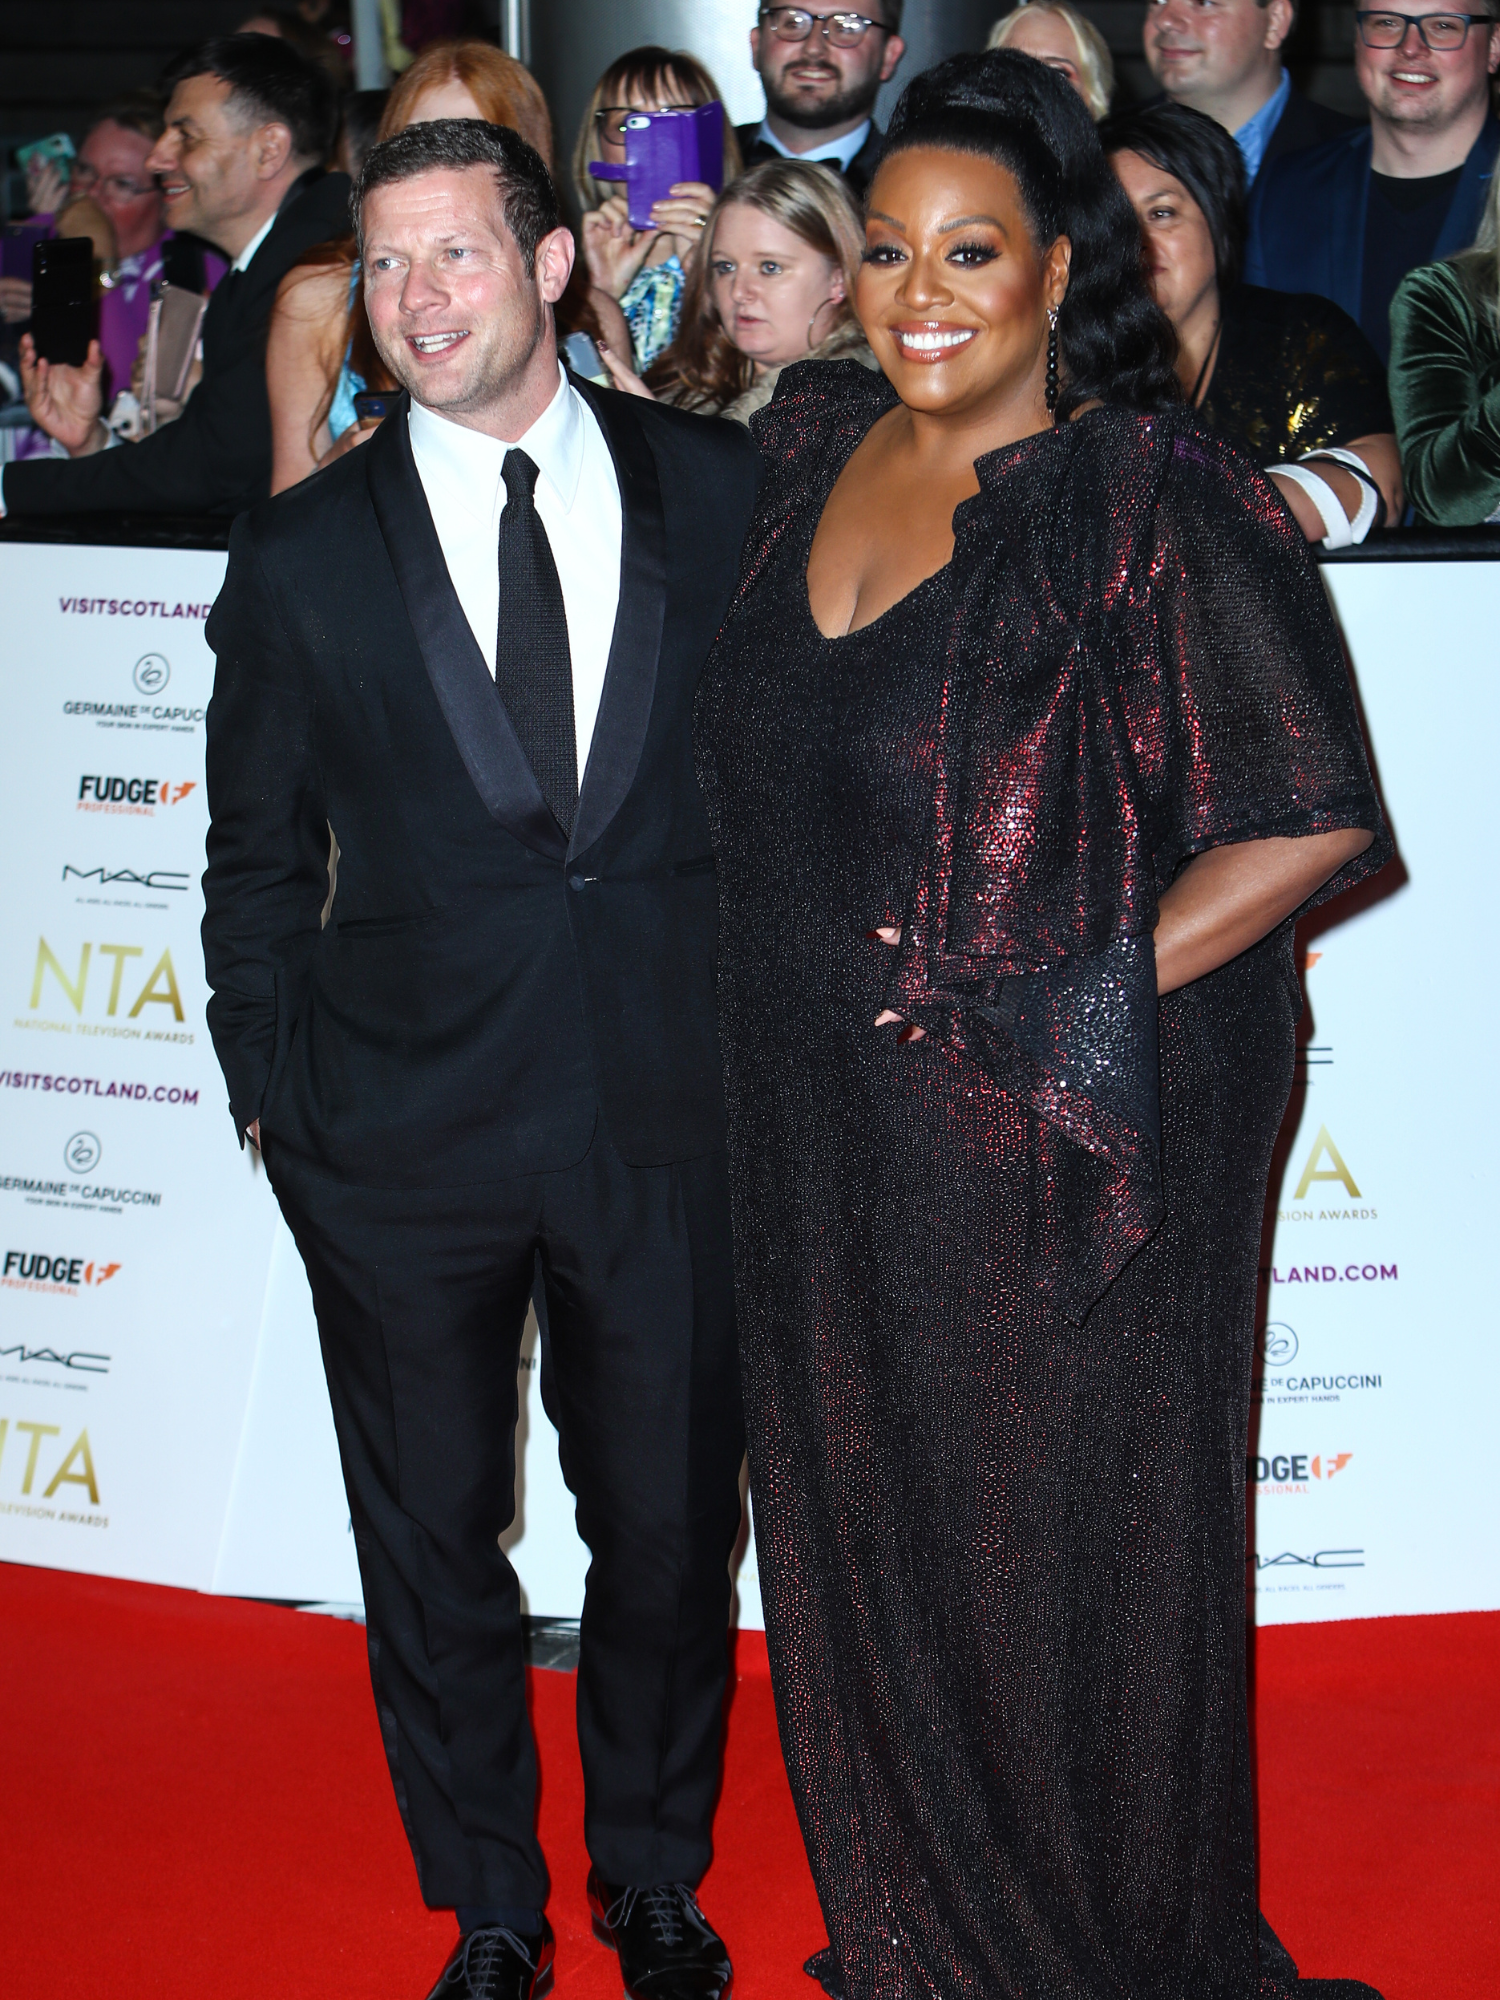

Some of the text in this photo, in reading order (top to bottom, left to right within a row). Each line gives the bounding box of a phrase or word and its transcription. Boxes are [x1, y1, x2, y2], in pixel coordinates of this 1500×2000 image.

[63, 701, 138, 718] GERMAINE
[152, 706, 207, 722] CAPUC
[78, 775, 159, 805] FUDGE
[77, 802, 156, 817] PROFESSIONAL
[30, 935, 185, 1023] NTA
[13, 1018, 196, 1045] NATIONAL TELEVISION AWARDS
[82, 1185, 162, 1207] CAPUCCINI
[1319, 1208, 1379, 1221] AWARDS
[3, 1252, 84, 1285] FUDGE
[1, 1277, 79, 1297] PROFESSIONAL
[1270, 1378, 1285, 1387] DE
[1286, 1374, 1383, 1392] CAPUCCINI
[0, 1417, 101, 1506] TA
[59, 1510, 109, 1529] AWARDS
